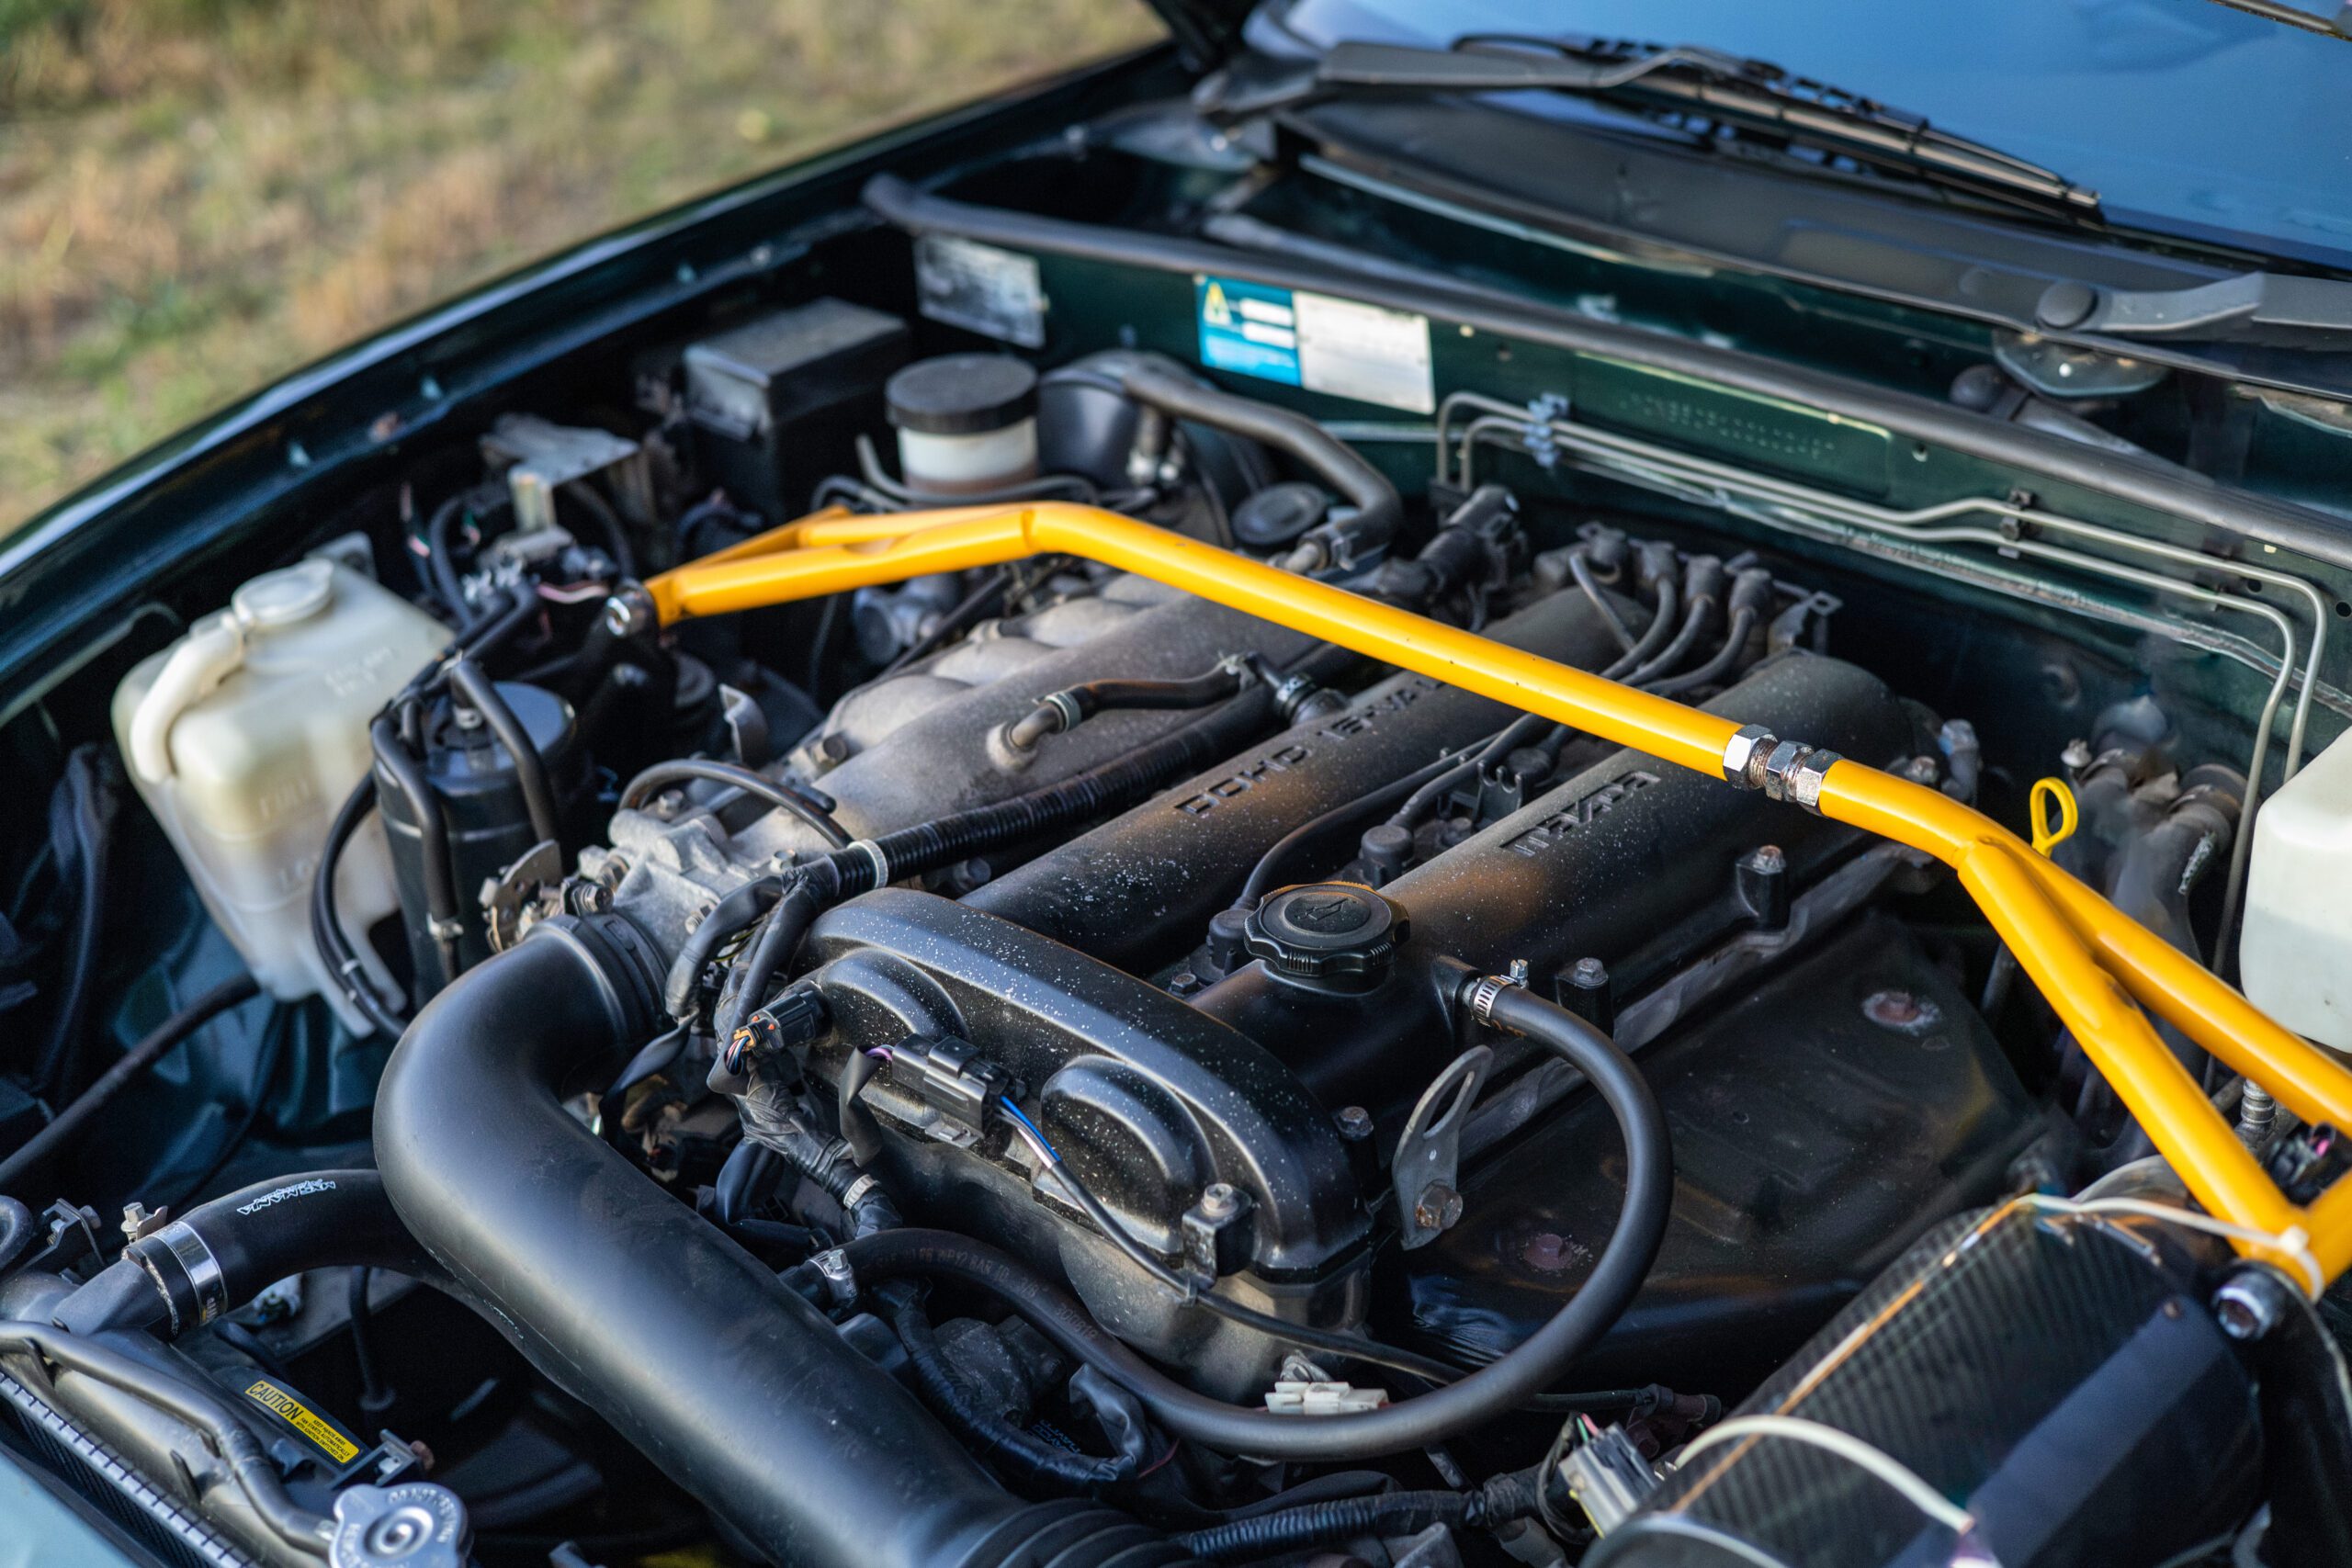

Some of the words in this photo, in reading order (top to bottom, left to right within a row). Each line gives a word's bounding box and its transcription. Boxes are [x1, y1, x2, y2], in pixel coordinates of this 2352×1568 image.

[249, 1382, 304, 1421] CAUTION
[312, 1419, 324, 1428] KEEP
[307, 1423, 322, 1435] STARTS
[321, 1433, 351, 1457] AUTOMATICALLY
[318, 1439, 339, 1455] SWITCHED
